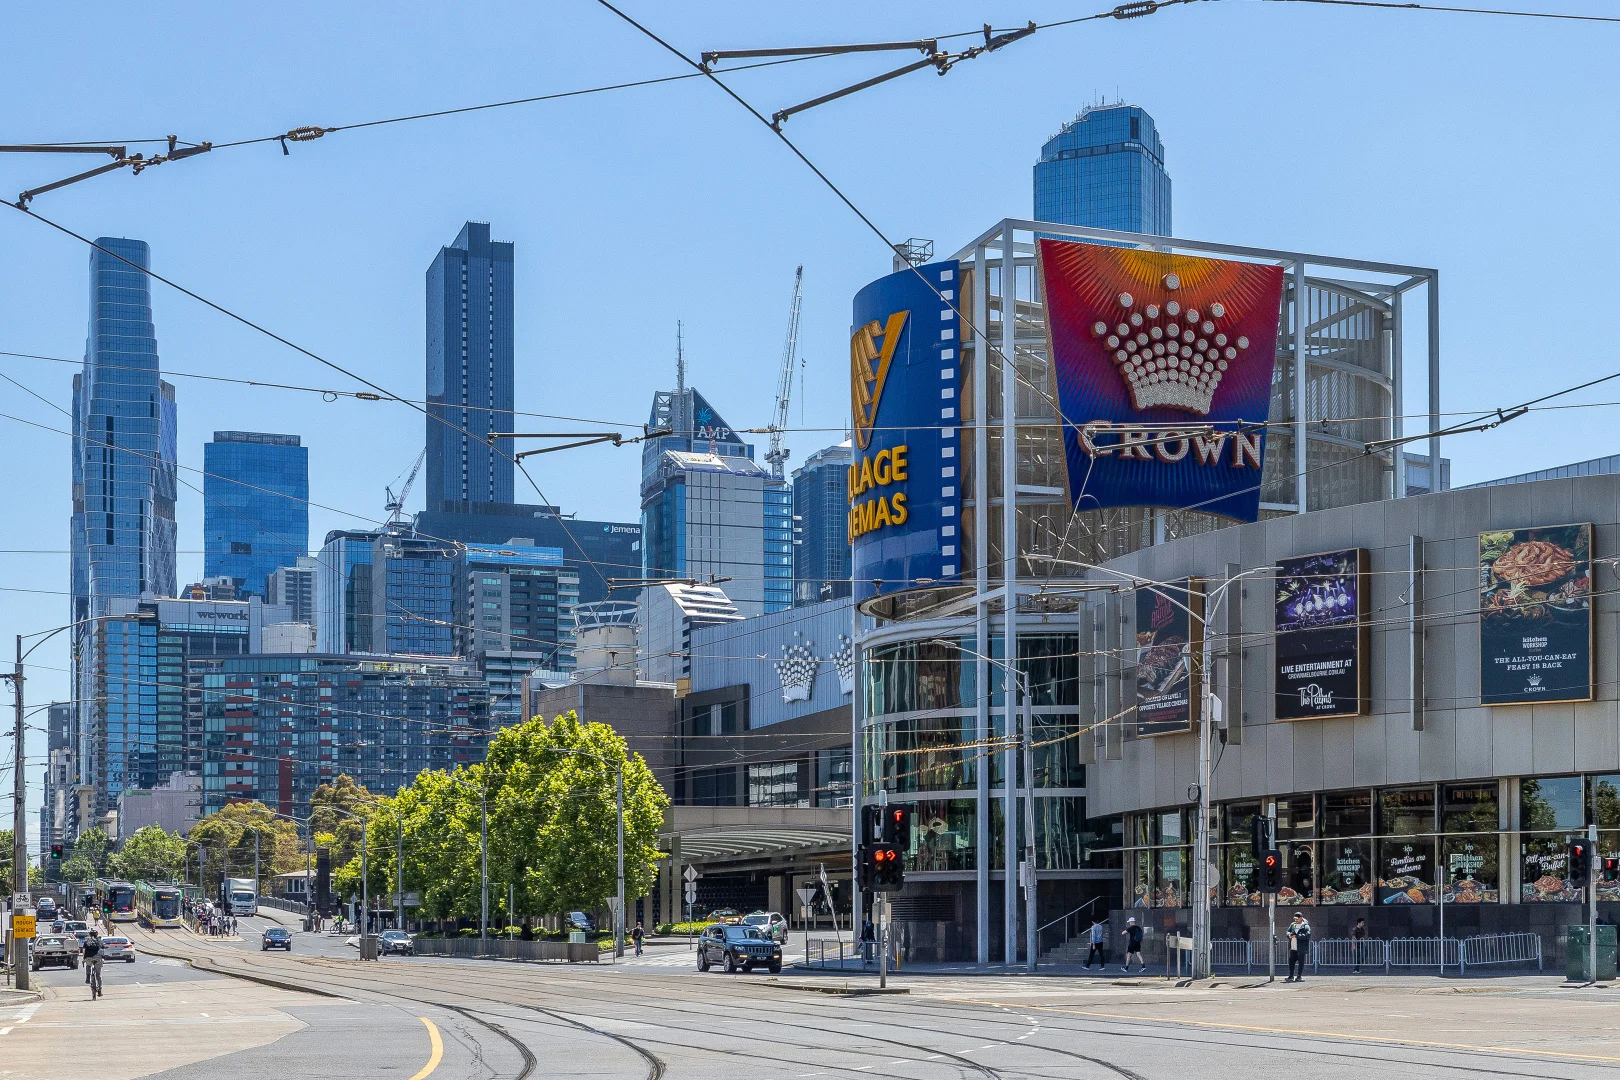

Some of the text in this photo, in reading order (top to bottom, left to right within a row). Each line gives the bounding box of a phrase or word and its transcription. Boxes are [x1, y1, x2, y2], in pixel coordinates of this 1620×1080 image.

[697, 425, 730, 440] AMP
[1077, 419, 1263, 470] CROWN
[610, 525, 641, 534] Jemena
[1522, 641, 1548, 649] WORKSHOP
[1511, 653, 1577, 663] ALL-YOU-CAN-EAT
[1281, 658, 1353, 674] LIVE ENTERTAINMENT AT
[1506, 663, 1531, 671] FEAST
[1542, 661, 1563, 669] BACK
[1297, 683, 1332, 708] The Palms
[1156, 701, 1171, 709] VILLAGE
[1390, 855, 1415, 866] Families
[1525, 853, 1570, 865] All-you-can-
[1396, 863, 1421, 874] welcome
[1541, 860, 1564, 870] Buffet
